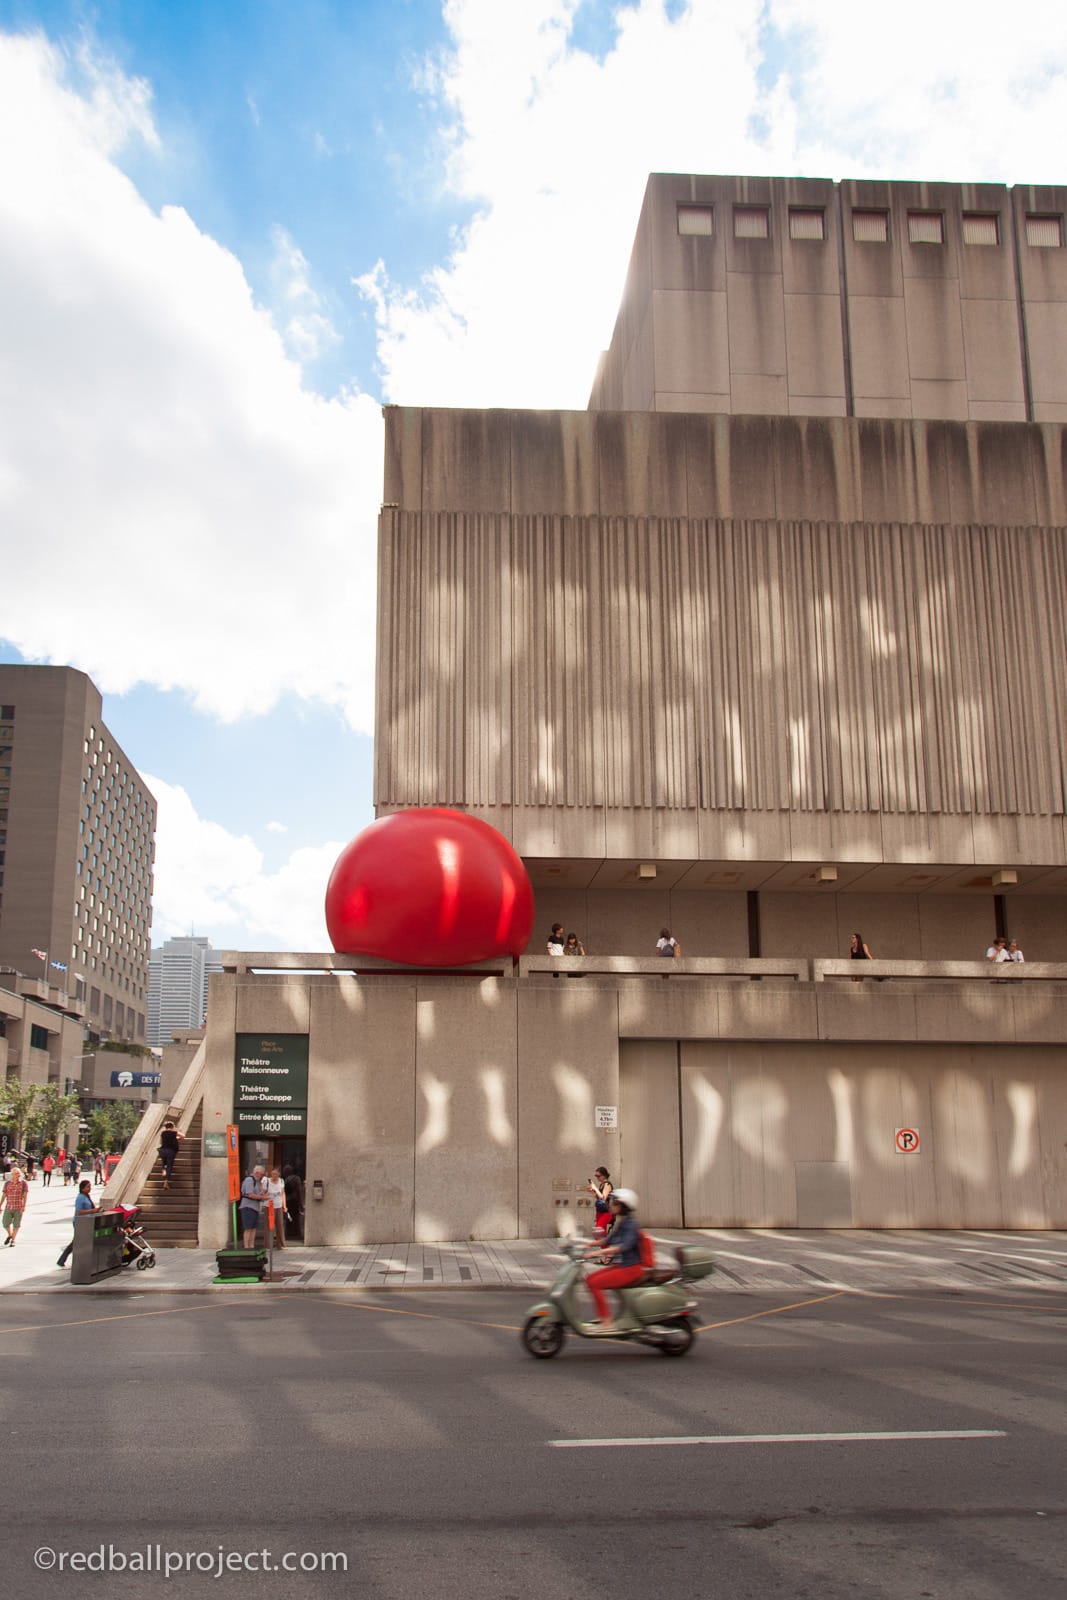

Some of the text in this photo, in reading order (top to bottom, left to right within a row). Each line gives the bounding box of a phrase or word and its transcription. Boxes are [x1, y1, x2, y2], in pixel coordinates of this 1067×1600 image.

[241, 1057, 270, 1066] Théâtre
[241, 1066, 289, 1074] Maisonneuve
[240, 1085, 269, 1093] Théâtre
[240, 1094, 292, 1102] Jean-Duceppe
[239, 1113, 302, 1121] Entrée des artistes
[260, 1123, 281, 1132] 1400
